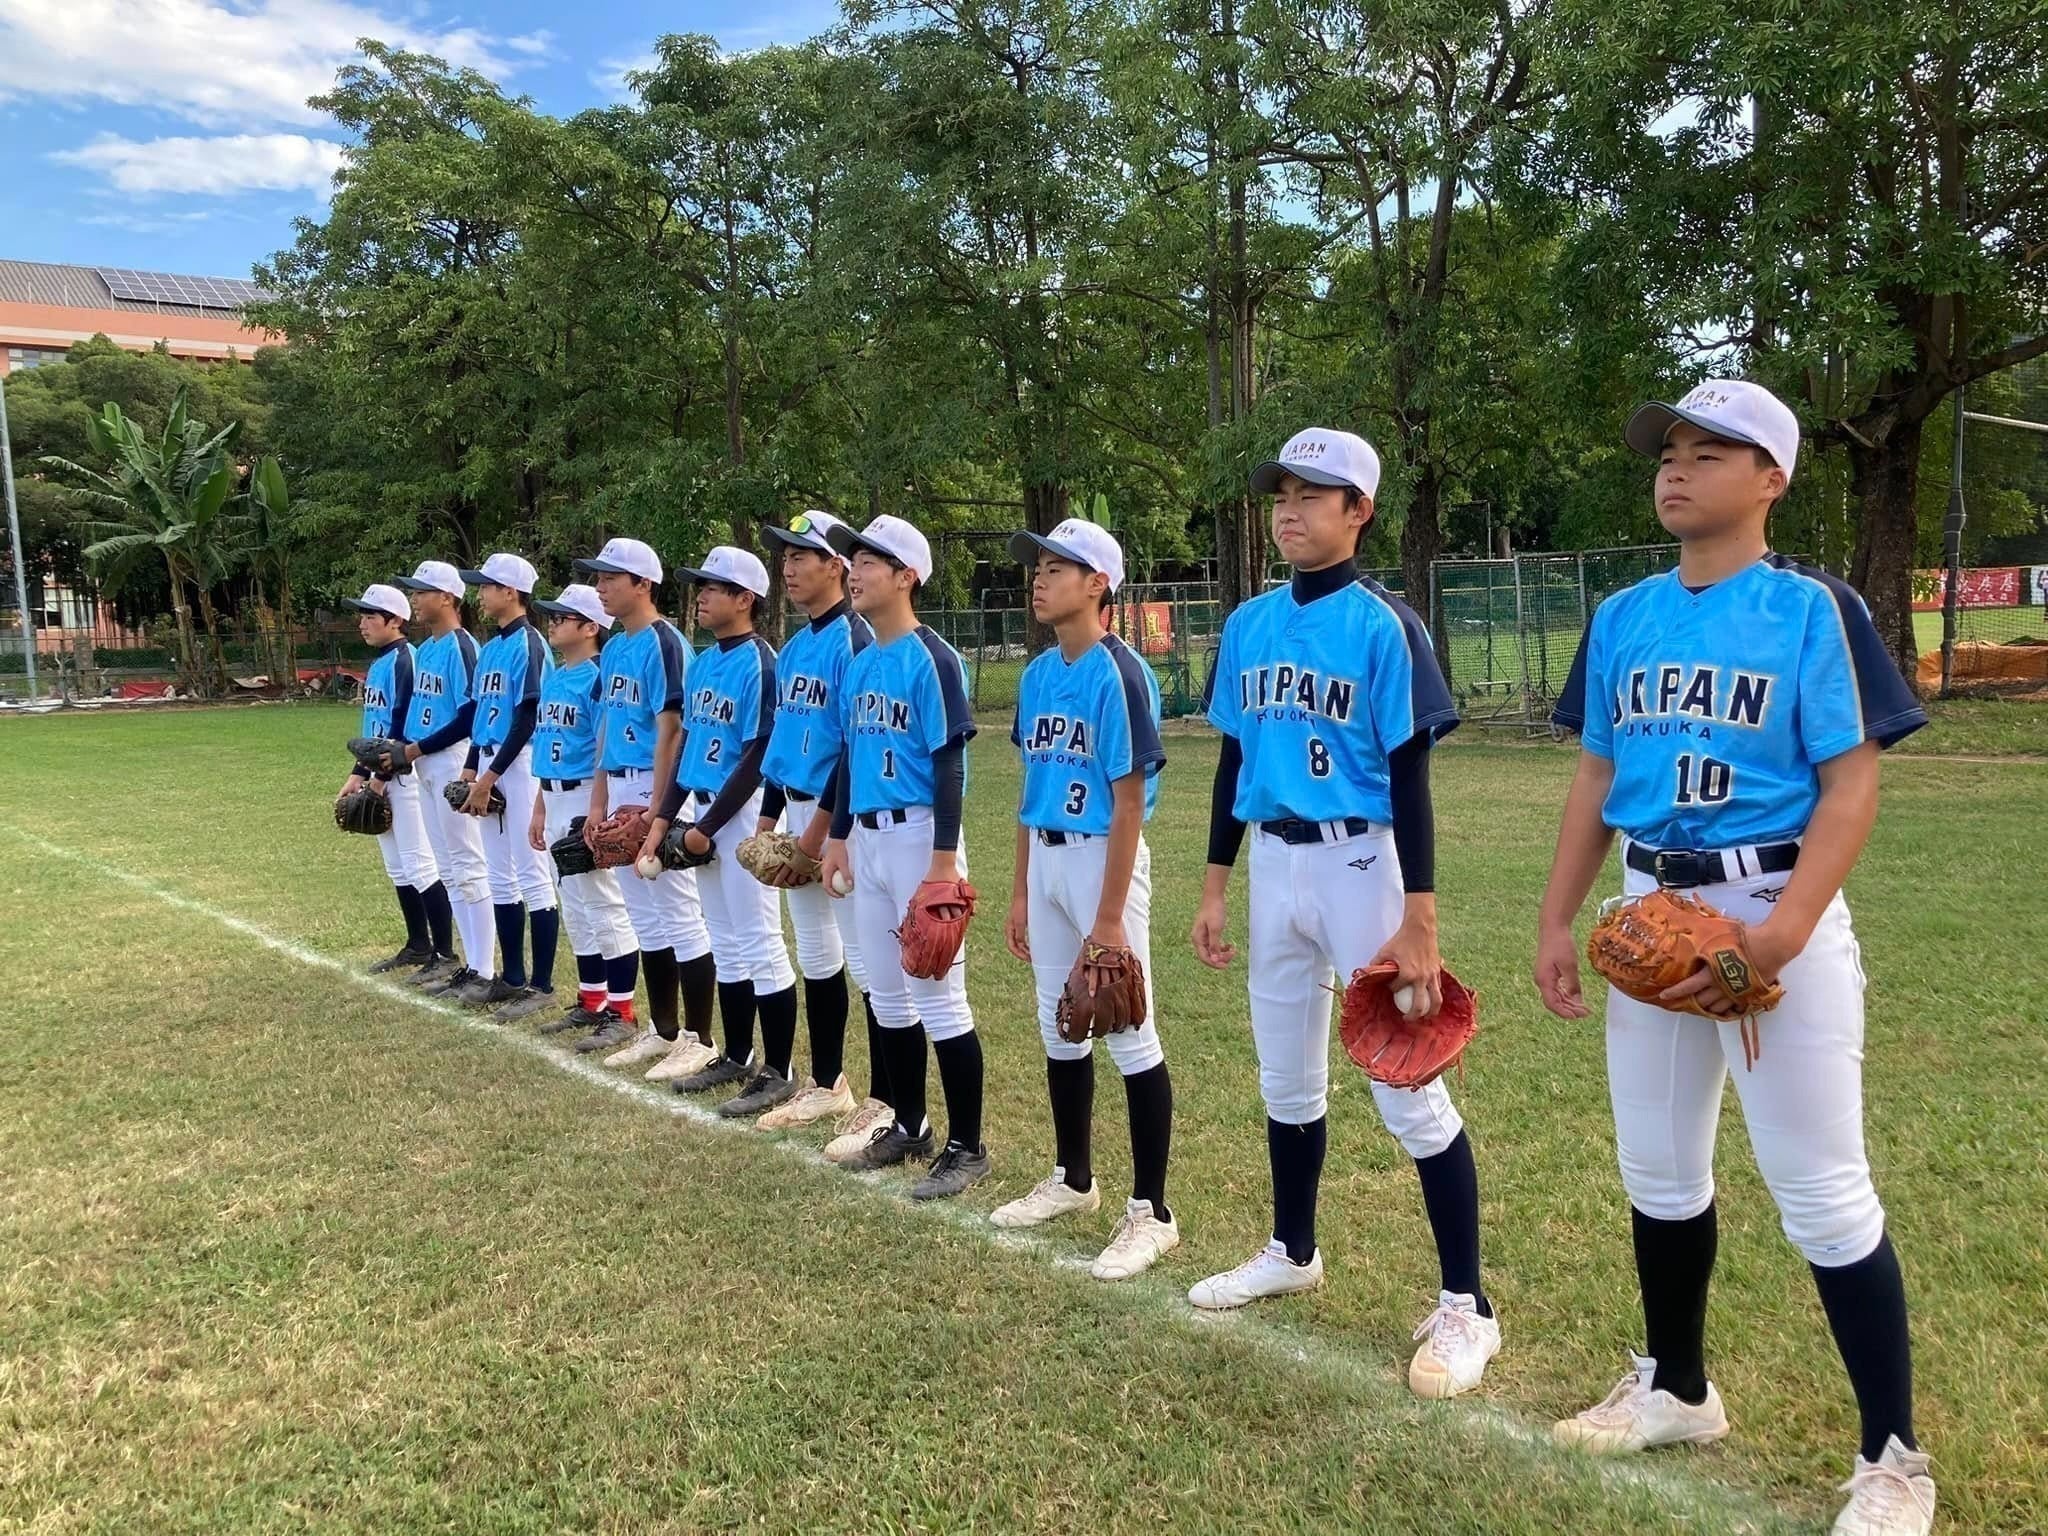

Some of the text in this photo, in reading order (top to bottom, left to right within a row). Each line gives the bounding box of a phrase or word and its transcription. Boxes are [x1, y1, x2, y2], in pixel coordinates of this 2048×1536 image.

[422, 707, 432, 726] 9
[488, 707, 499, 726] 7
[550, 741, 562, 764] 5
[705, 738, 723, 764] 2
[882, 749, 896, 779] 1
[1308, 736, 1331, 778] 8
[1675, 754, 1732, 804] 10
[1065, 781, 1089, 816] 3
[1718, 953, 1745, 990] ZETT
